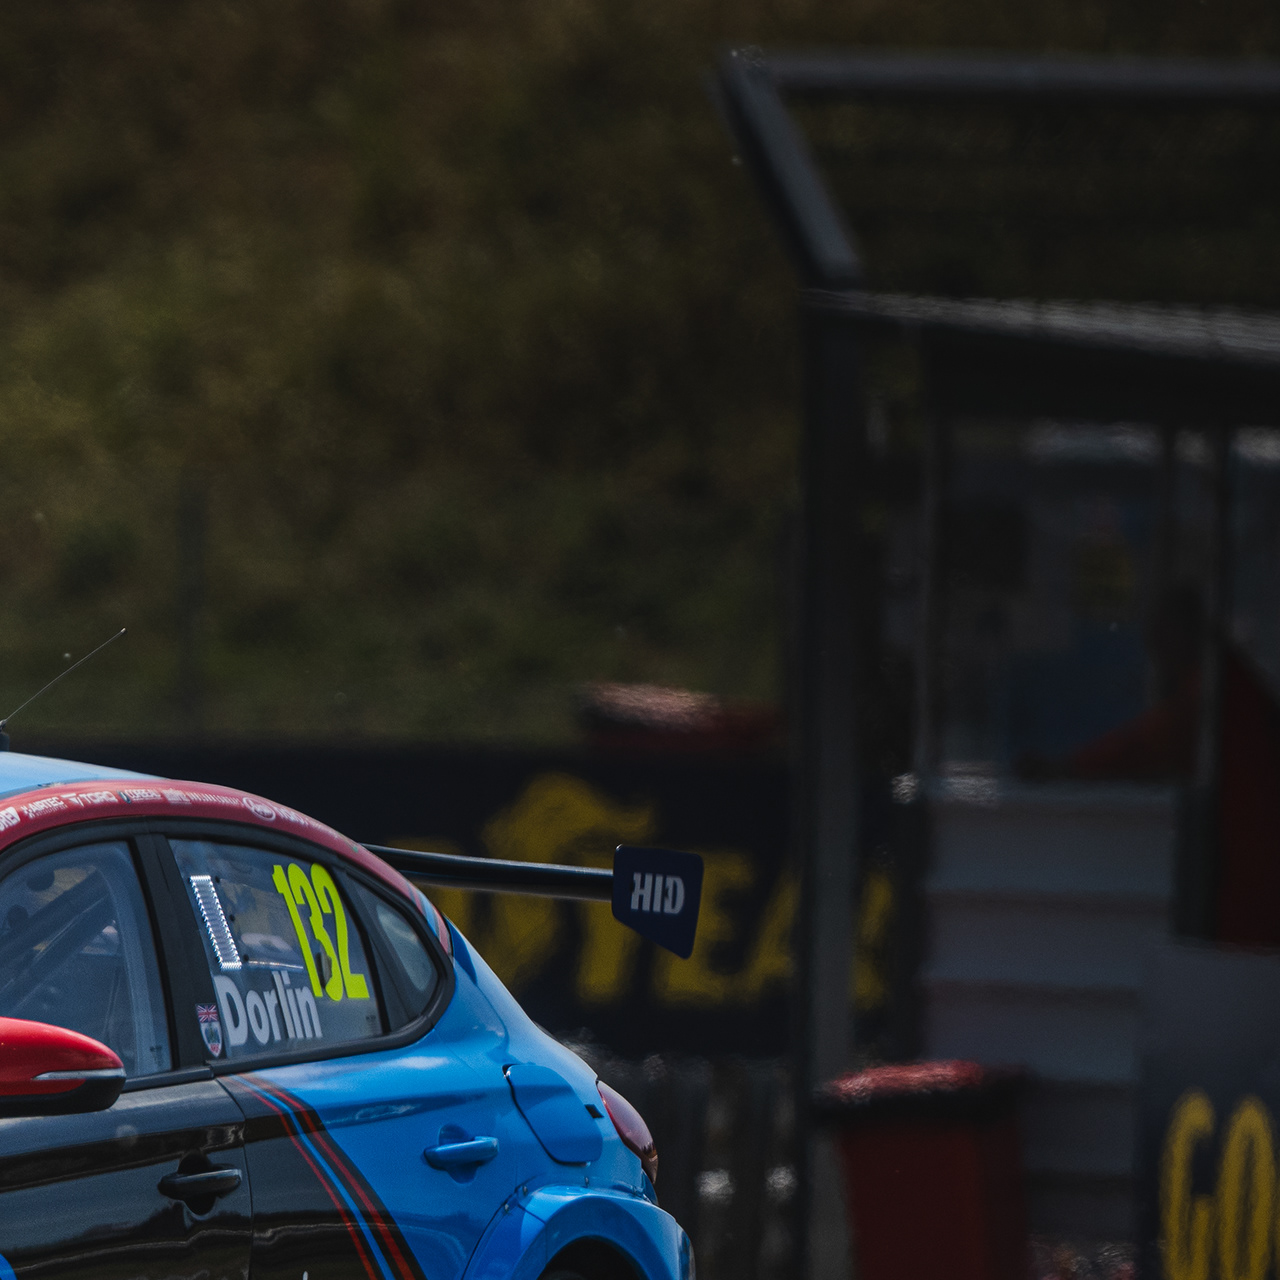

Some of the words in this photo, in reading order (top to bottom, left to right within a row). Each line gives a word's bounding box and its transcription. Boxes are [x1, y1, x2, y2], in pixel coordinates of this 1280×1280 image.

[271, 862, 370, 1001] 132
[630, 871, 686, 915] HID
[213, 970, 323, 1047] Dorlin
